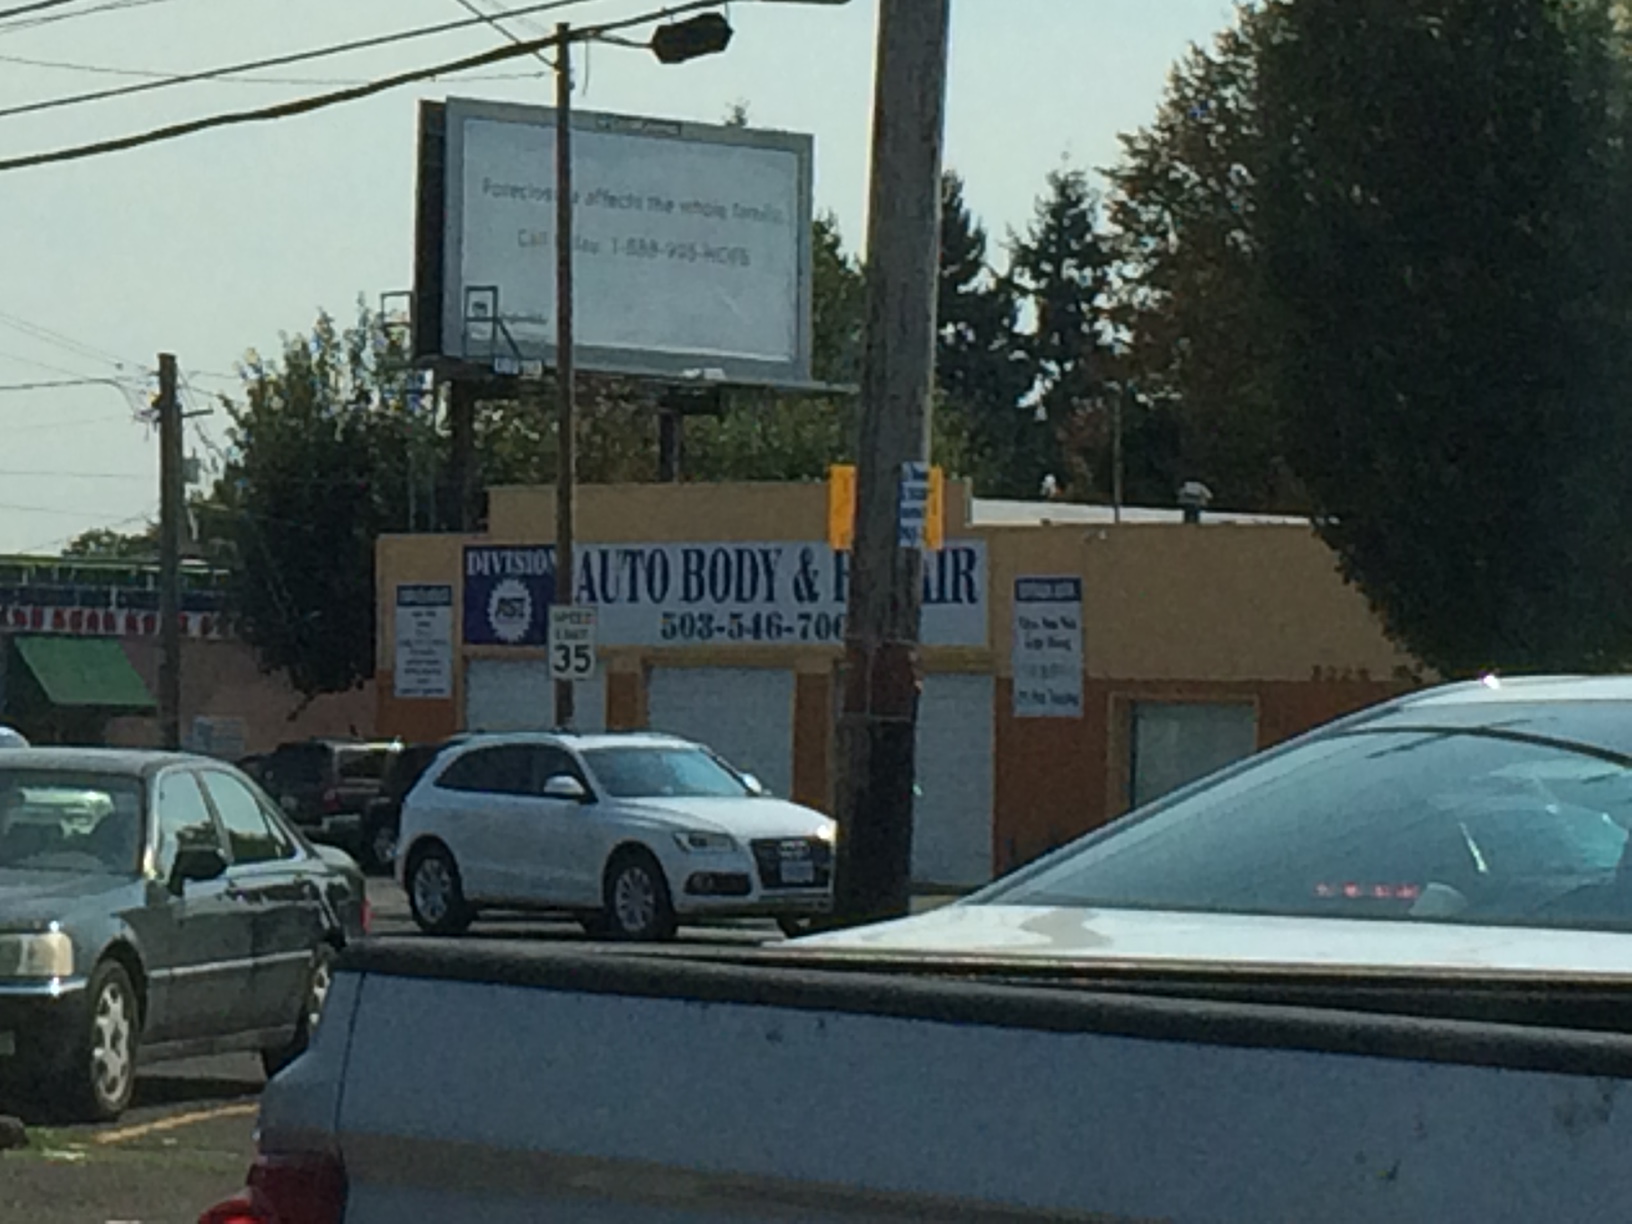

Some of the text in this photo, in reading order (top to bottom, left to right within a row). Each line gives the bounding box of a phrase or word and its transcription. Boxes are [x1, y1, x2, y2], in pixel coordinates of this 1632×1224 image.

[574, 547, 669, 605] AUTO
[678, 546, 782, 605] BODY
[792, 546, 820, 604] &
[553, 643, 592, 674] 35
